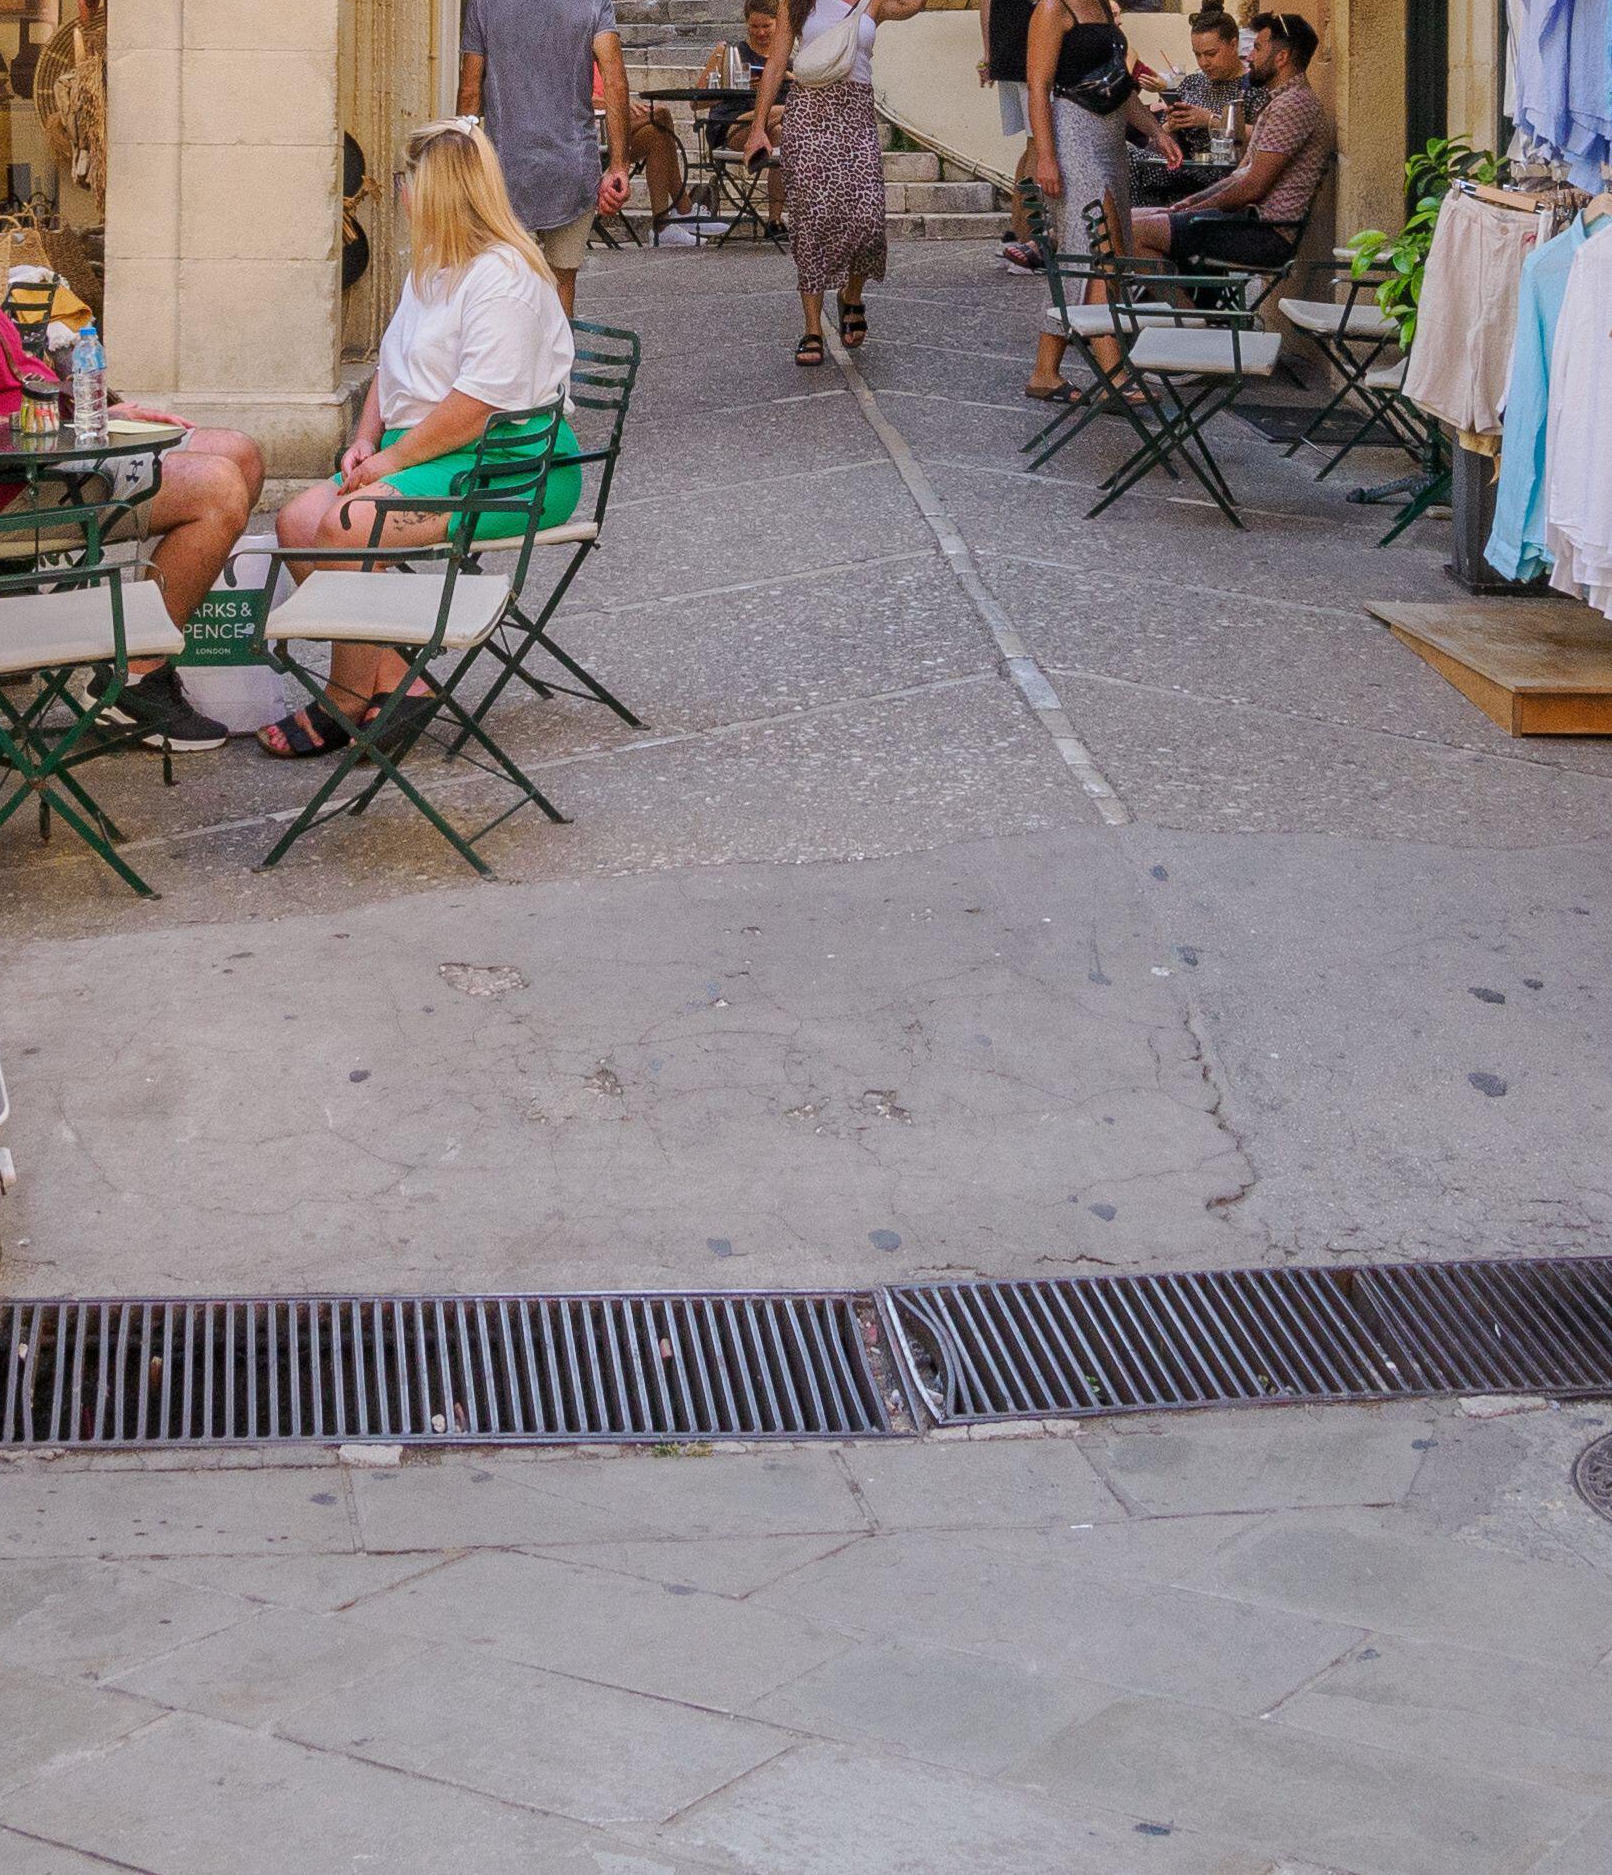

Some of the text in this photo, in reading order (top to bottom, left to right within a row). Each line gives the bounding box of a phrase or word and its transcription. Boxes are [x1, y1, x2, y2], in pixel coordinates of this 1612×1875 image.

[194, 602, 253, 618] ARKS &
[182, 622, 256, 640] PENCE
[195, 647, 232, 656] LONDON
